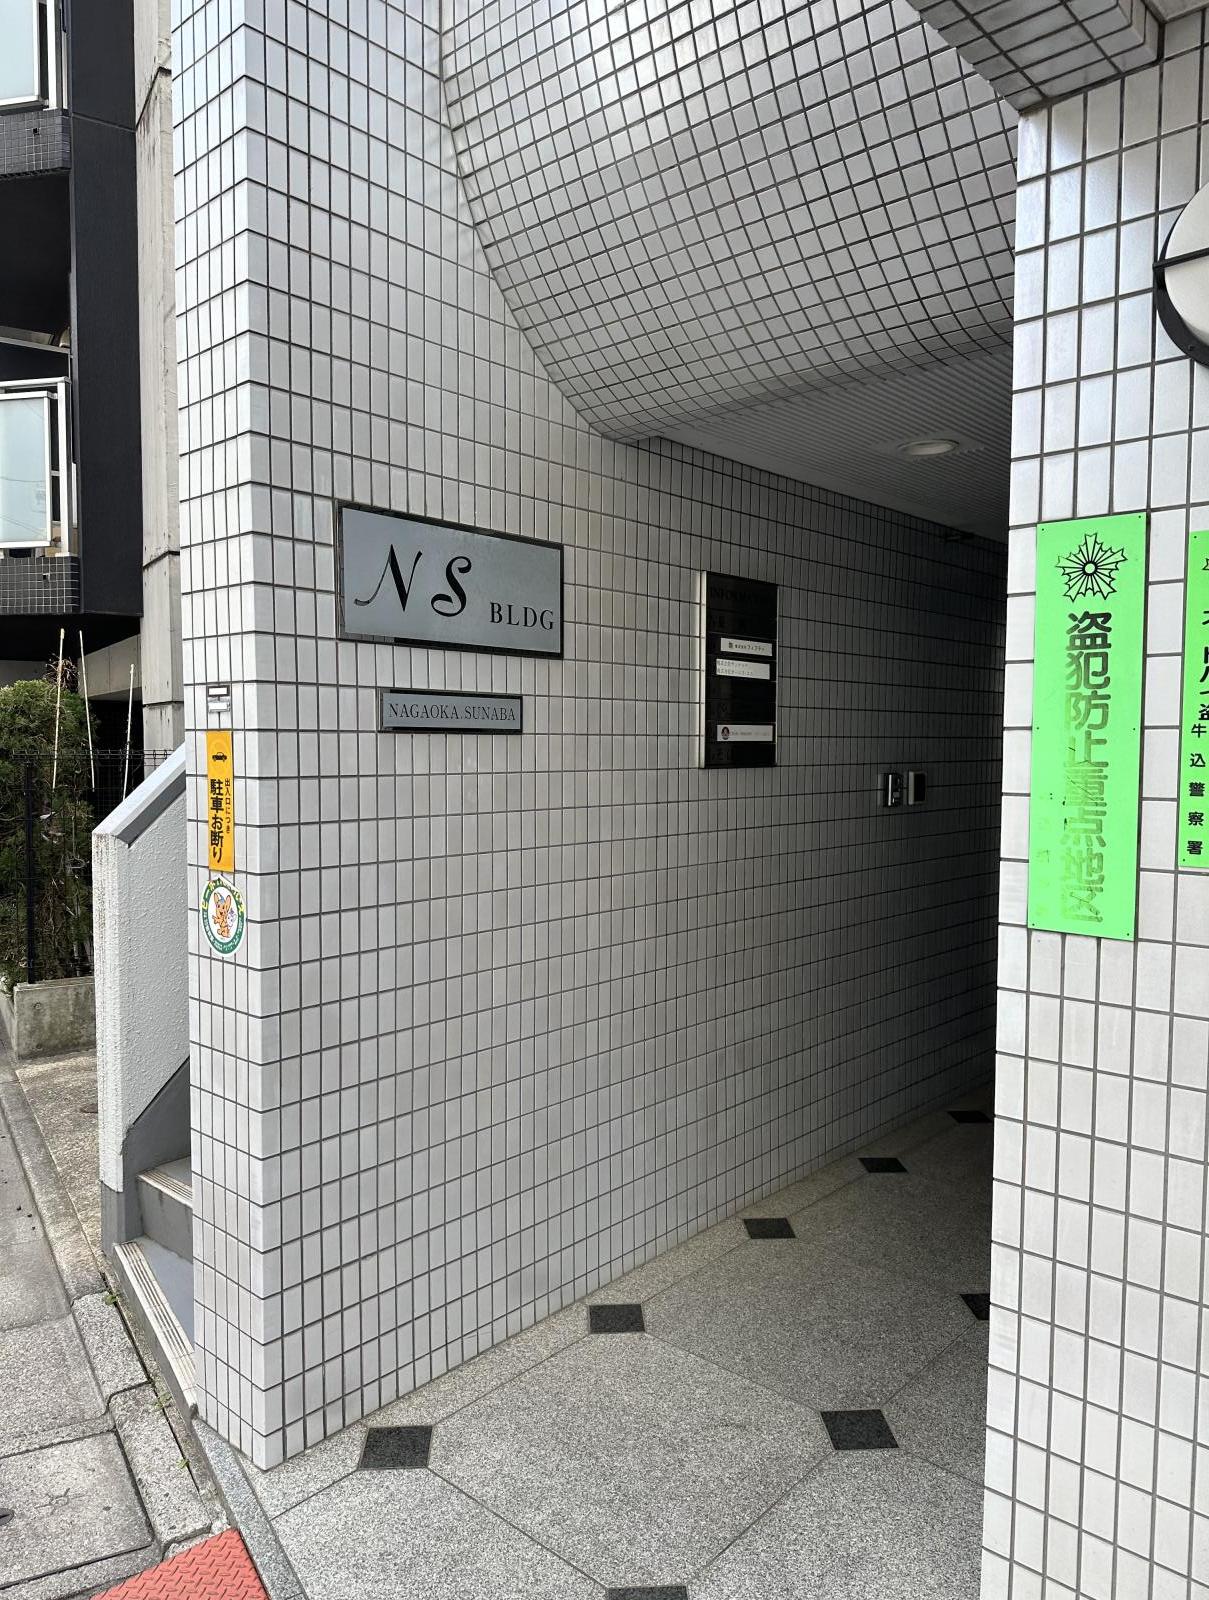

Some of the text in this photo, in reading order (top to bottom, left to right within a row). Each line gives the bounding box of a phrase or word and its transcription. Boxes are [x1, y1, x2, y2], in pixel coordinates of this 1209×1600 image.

[490, 602, 554, 631] BLDG
[210, 779, 224, 863] 駐車お断り
[1187, 723, 1207, 855] 牛込警察署
